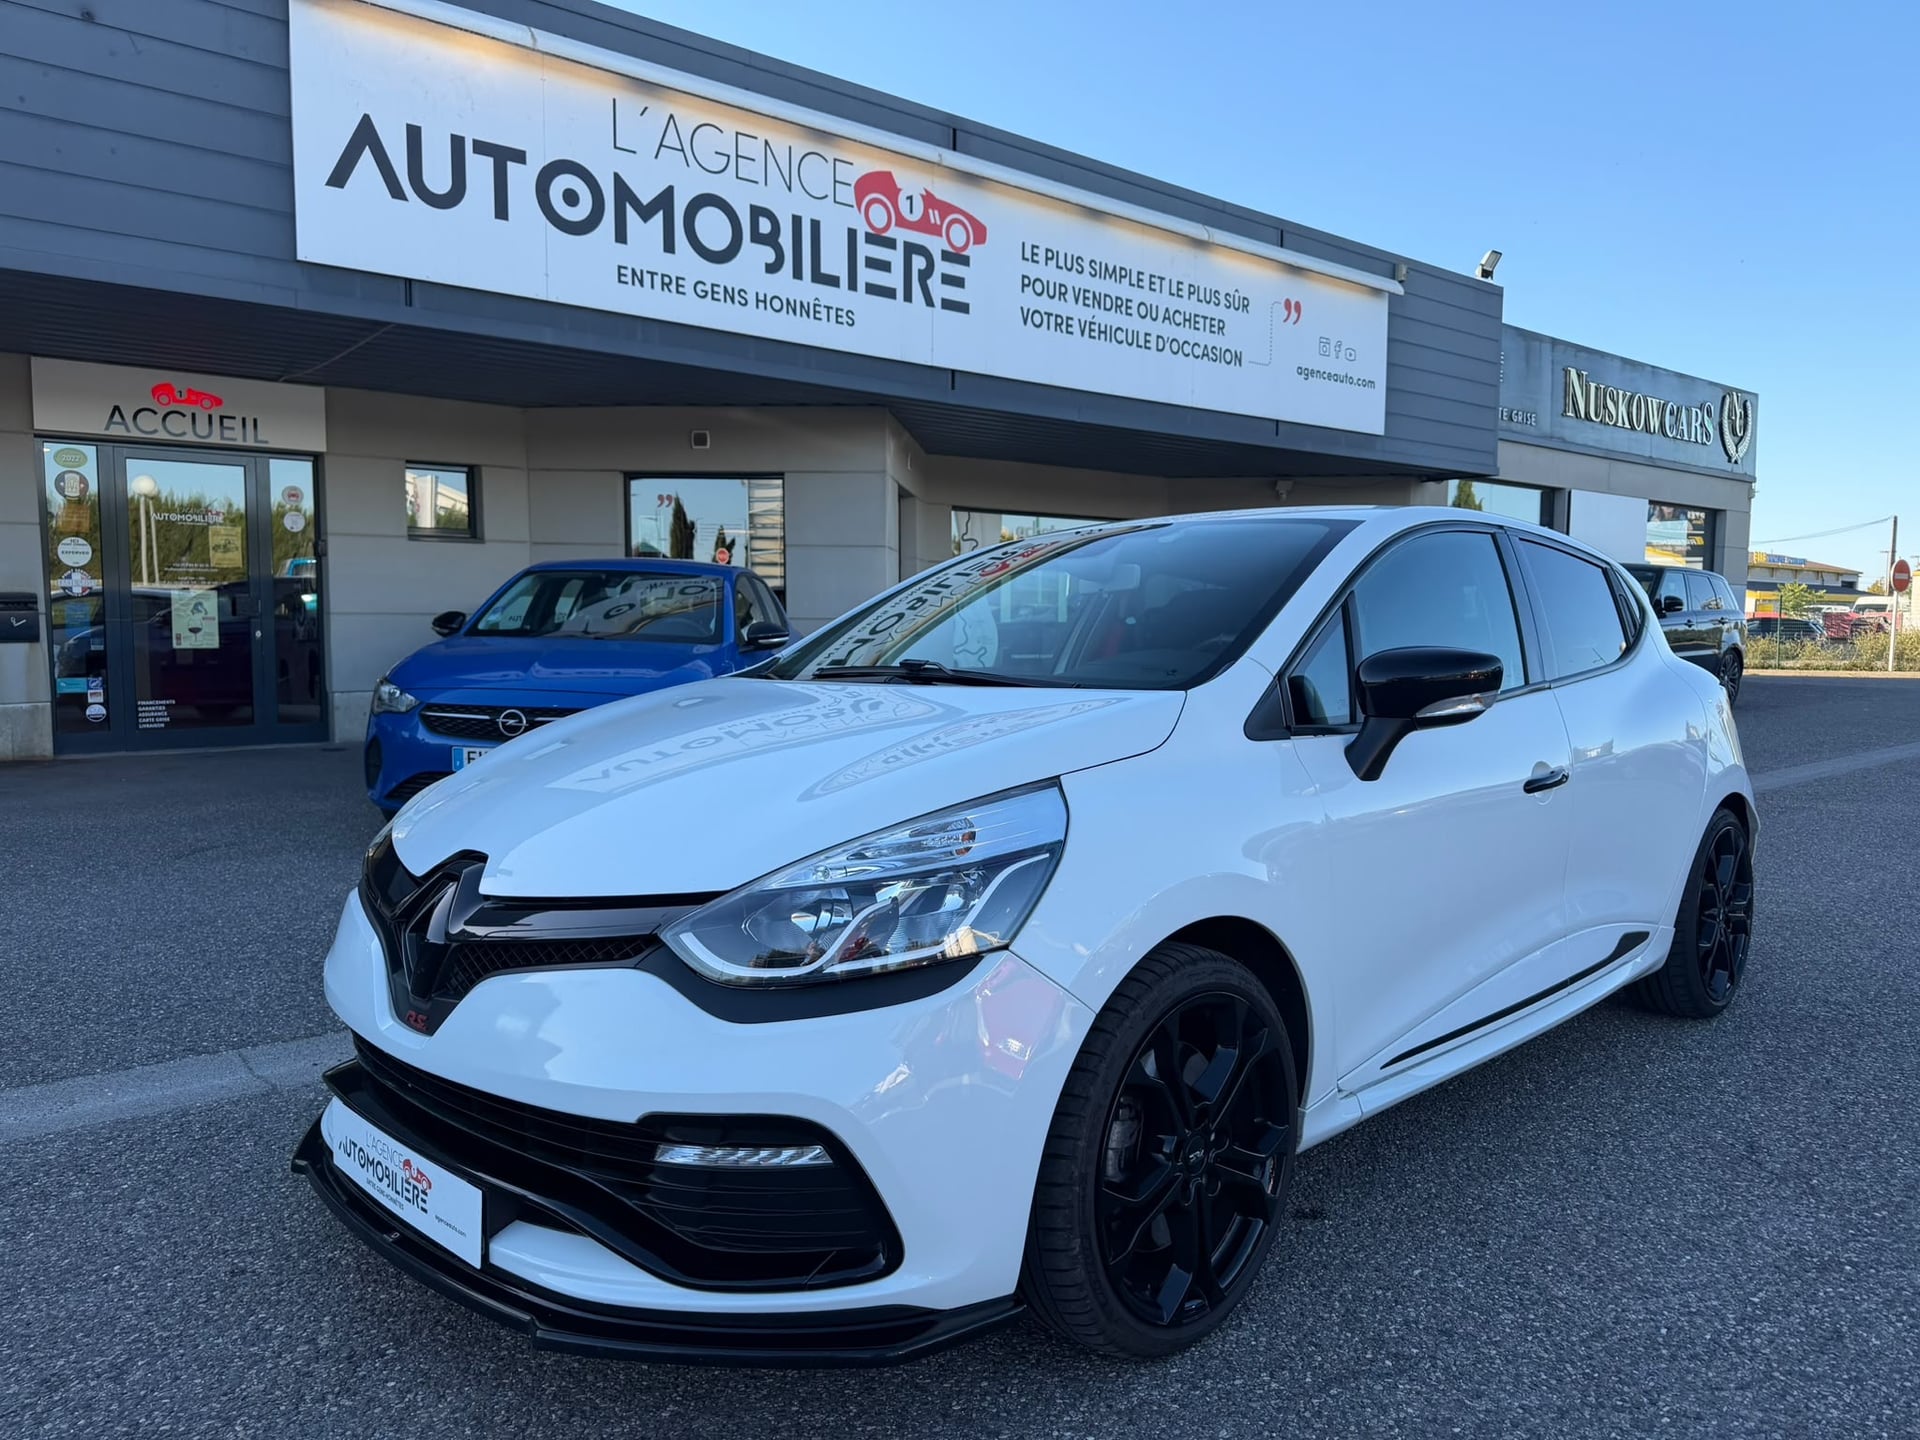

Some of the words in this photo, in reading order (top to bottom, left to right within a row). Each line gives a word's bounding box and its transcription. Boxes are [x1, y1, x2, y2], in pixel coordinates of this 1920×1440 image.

[612, 97, 855, 208] L'AGENCE
[325, 113, 970, 314] AUTOMOBILIERE
[617, 265, 687, 296] ENTRE
[693, 279, 749, 307] GENS
[755, 292, 856, 327] HONNÊTES
[1021, 274, 1068, 303] POUR
[1072, 286, 1133, 317] VENDRE
[1137, 301, 1159, 322] OU
[1162, 307, 1226, 336] ACHETER
[1022, 241, 1040, 264] LE
[1045, 248, 1085, 275] PLUS
[1088, 259, 1145, 290] SIMPLE
[1149, 274, 1166, 294] ET
[1168, 278, 1184, 298] LE
[1188, 283, 1221, 307] PLUS
[1224, 288, 1250, 314] SÛR
[1020, 306, 1074, 336] VOTRE
[1077, 314, 1152, 350] VÉHICULE
[1156, 334, 1243, 367] D'OCCASION
[1296, 363, 1376, 390] agenceauto.com
[104, 405, 269, 444] ACCUEIL
[1511, 409, 1537, 426] GRISE
